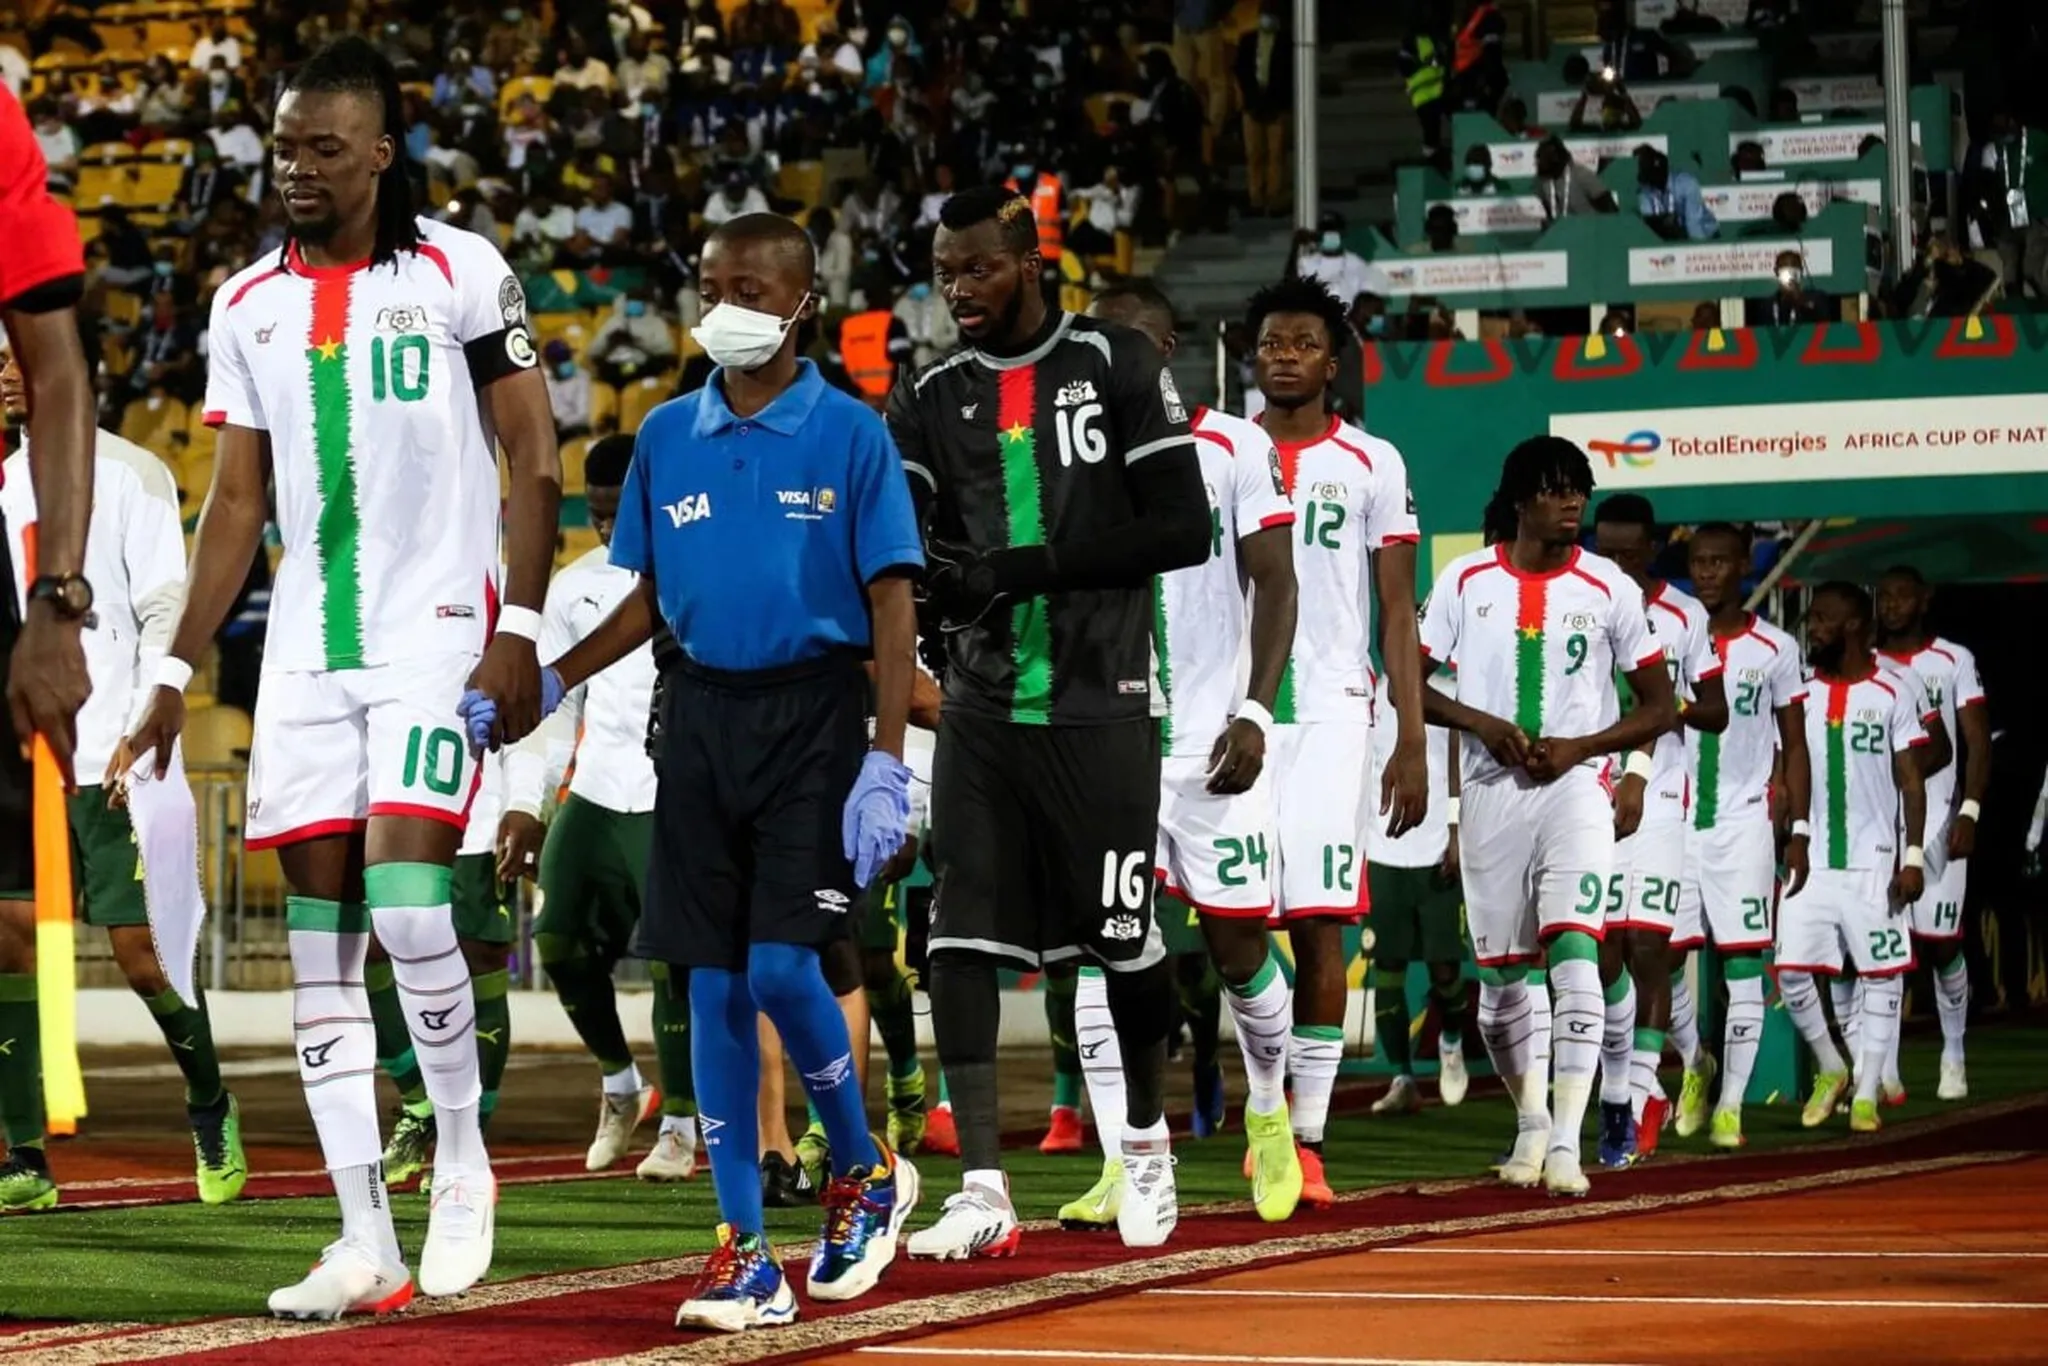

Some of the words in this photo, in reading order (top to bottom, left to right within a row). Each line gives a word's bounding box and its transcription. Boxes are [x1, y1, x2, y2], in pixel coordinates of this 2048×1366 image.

[371, 334, 430, 402] 10
[1056, 403, 1106, 467] 16
[1667, 431, 1827, 458] TotalEnergies
[1844, 431, 1919, 450] AFRICA
[1925, 429, 1967, 446] CUP
[1971, 428, 2001, 445] OF
[2006, 426, 2048, 443] NAT
[775, 490, 812, 505] VISA
[1304, 500, 1345, 550] 12
[1565, 633, 1588, 676] 9
[1734, 681, 1762, 717] 21
[1851, 721, 1884, 755] 22
[402, 725, 464, 797] 10
[1101, 850, 1146, 910] 16
[1212, 831, 1268, 886] 24
[1323, 844, 1353, 891] 12
[1575, 872, 1603, 915] 9
[1641, 876, 1681, 915] 20
[1741, 896, 1769, 931] 21
[1934, 901, 1957, 930] 14
[1868, 928, 1907, 961] 22
